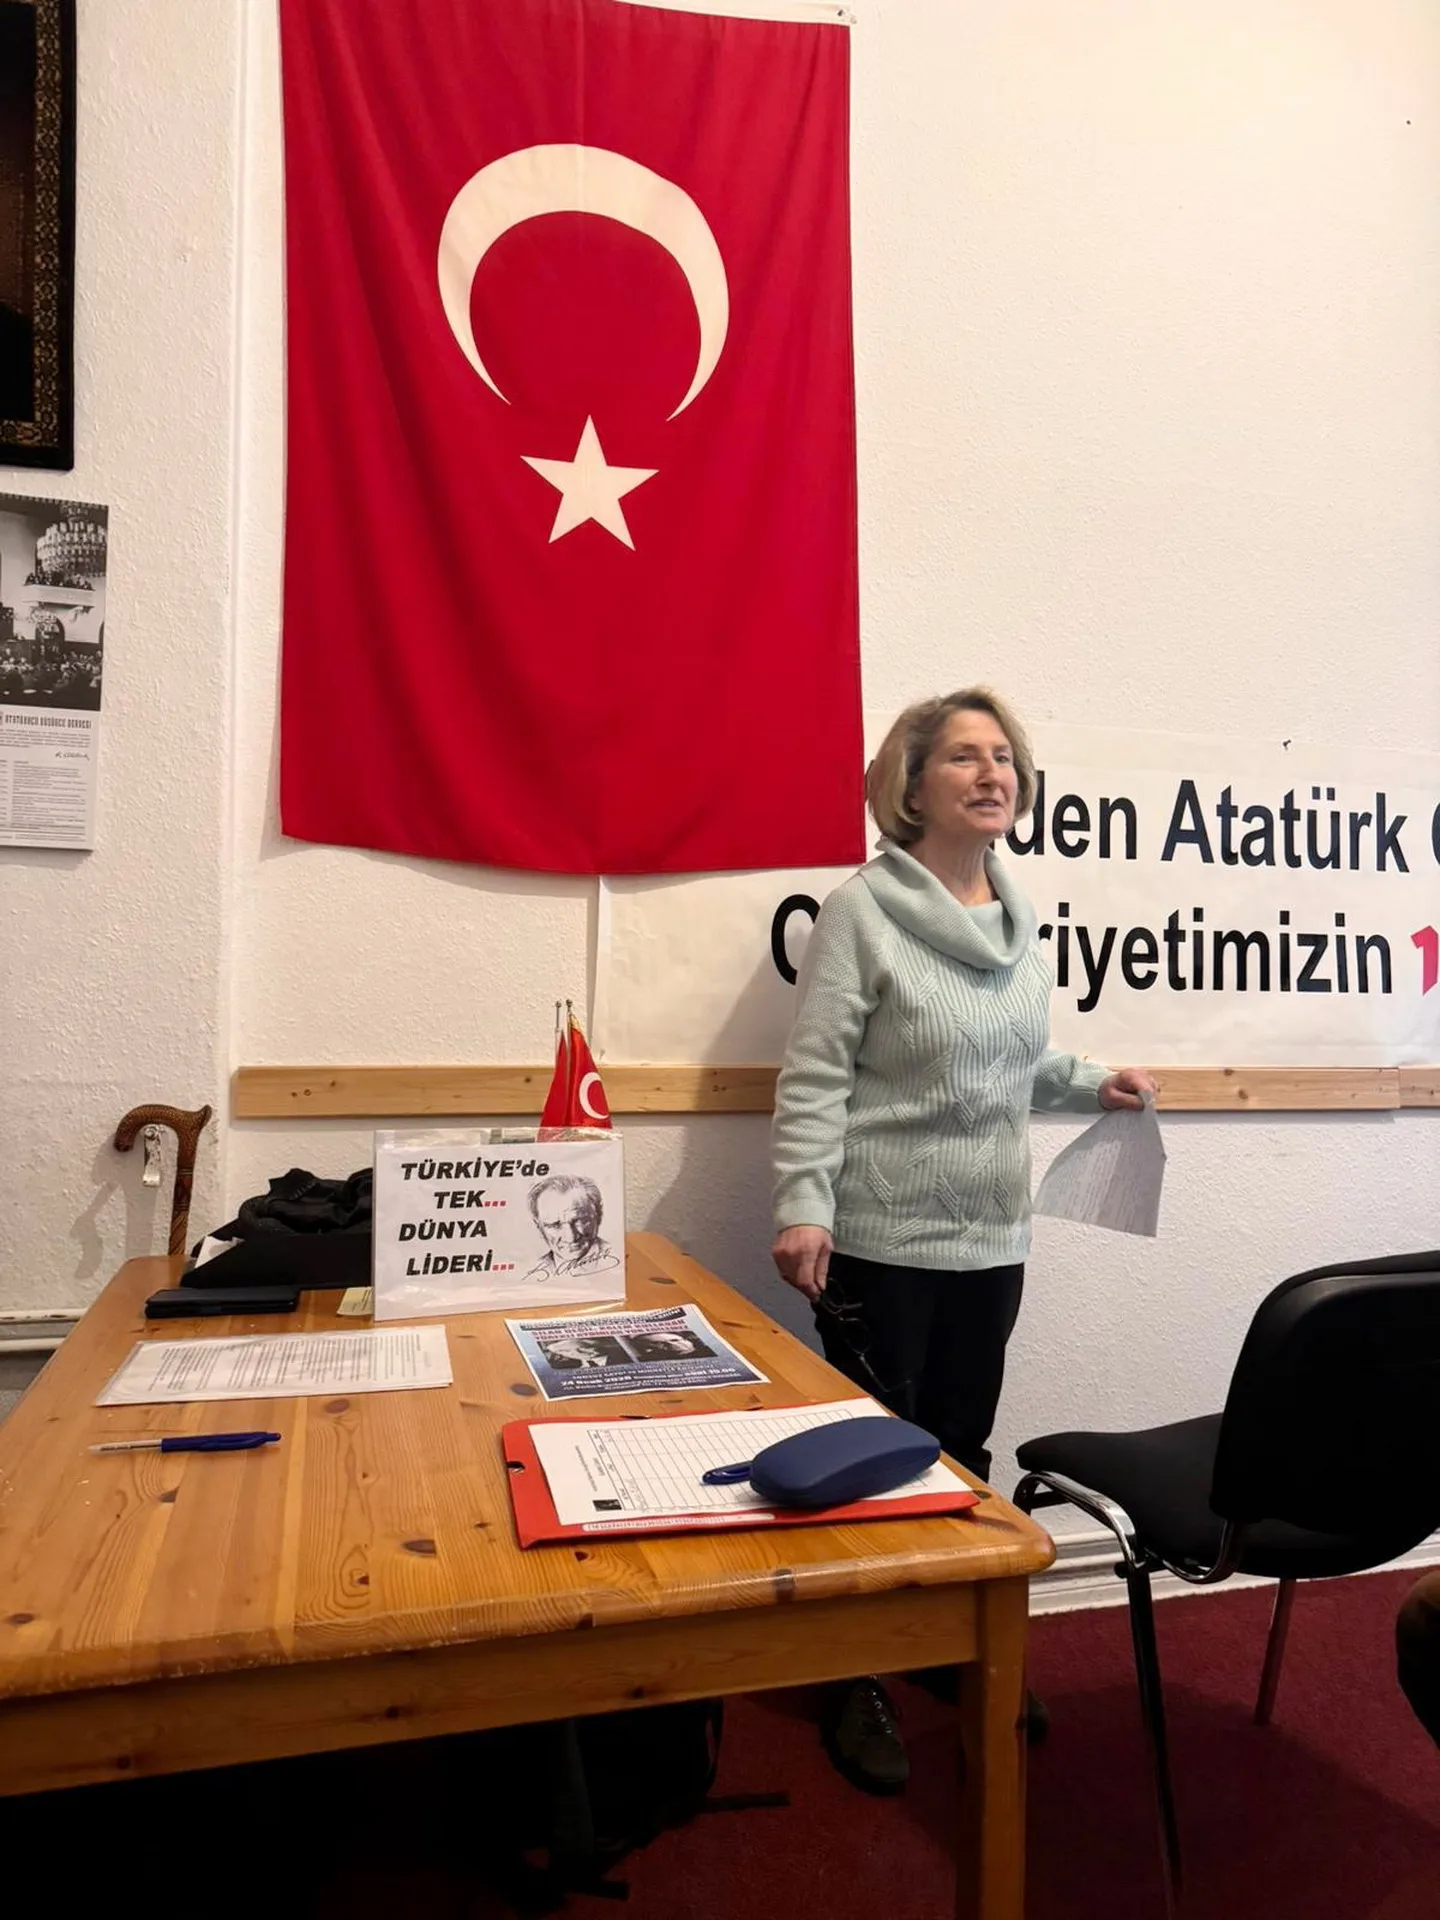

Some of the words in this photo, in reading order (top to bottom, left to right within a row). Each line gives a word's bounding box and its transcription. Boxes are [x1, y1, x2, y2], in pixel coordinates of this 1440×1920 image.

[990, 769, 1138, 859] den
[1160, 779, 1411, 873] Atatürk
[771, 893, 1393, 1013] Ciyetimizin
[434, 1190, 507, 1209] TEK...
[398, 1218, 488, 1242] DÜNYA
[406, 1248, 515, 1276] LİDERİ...
